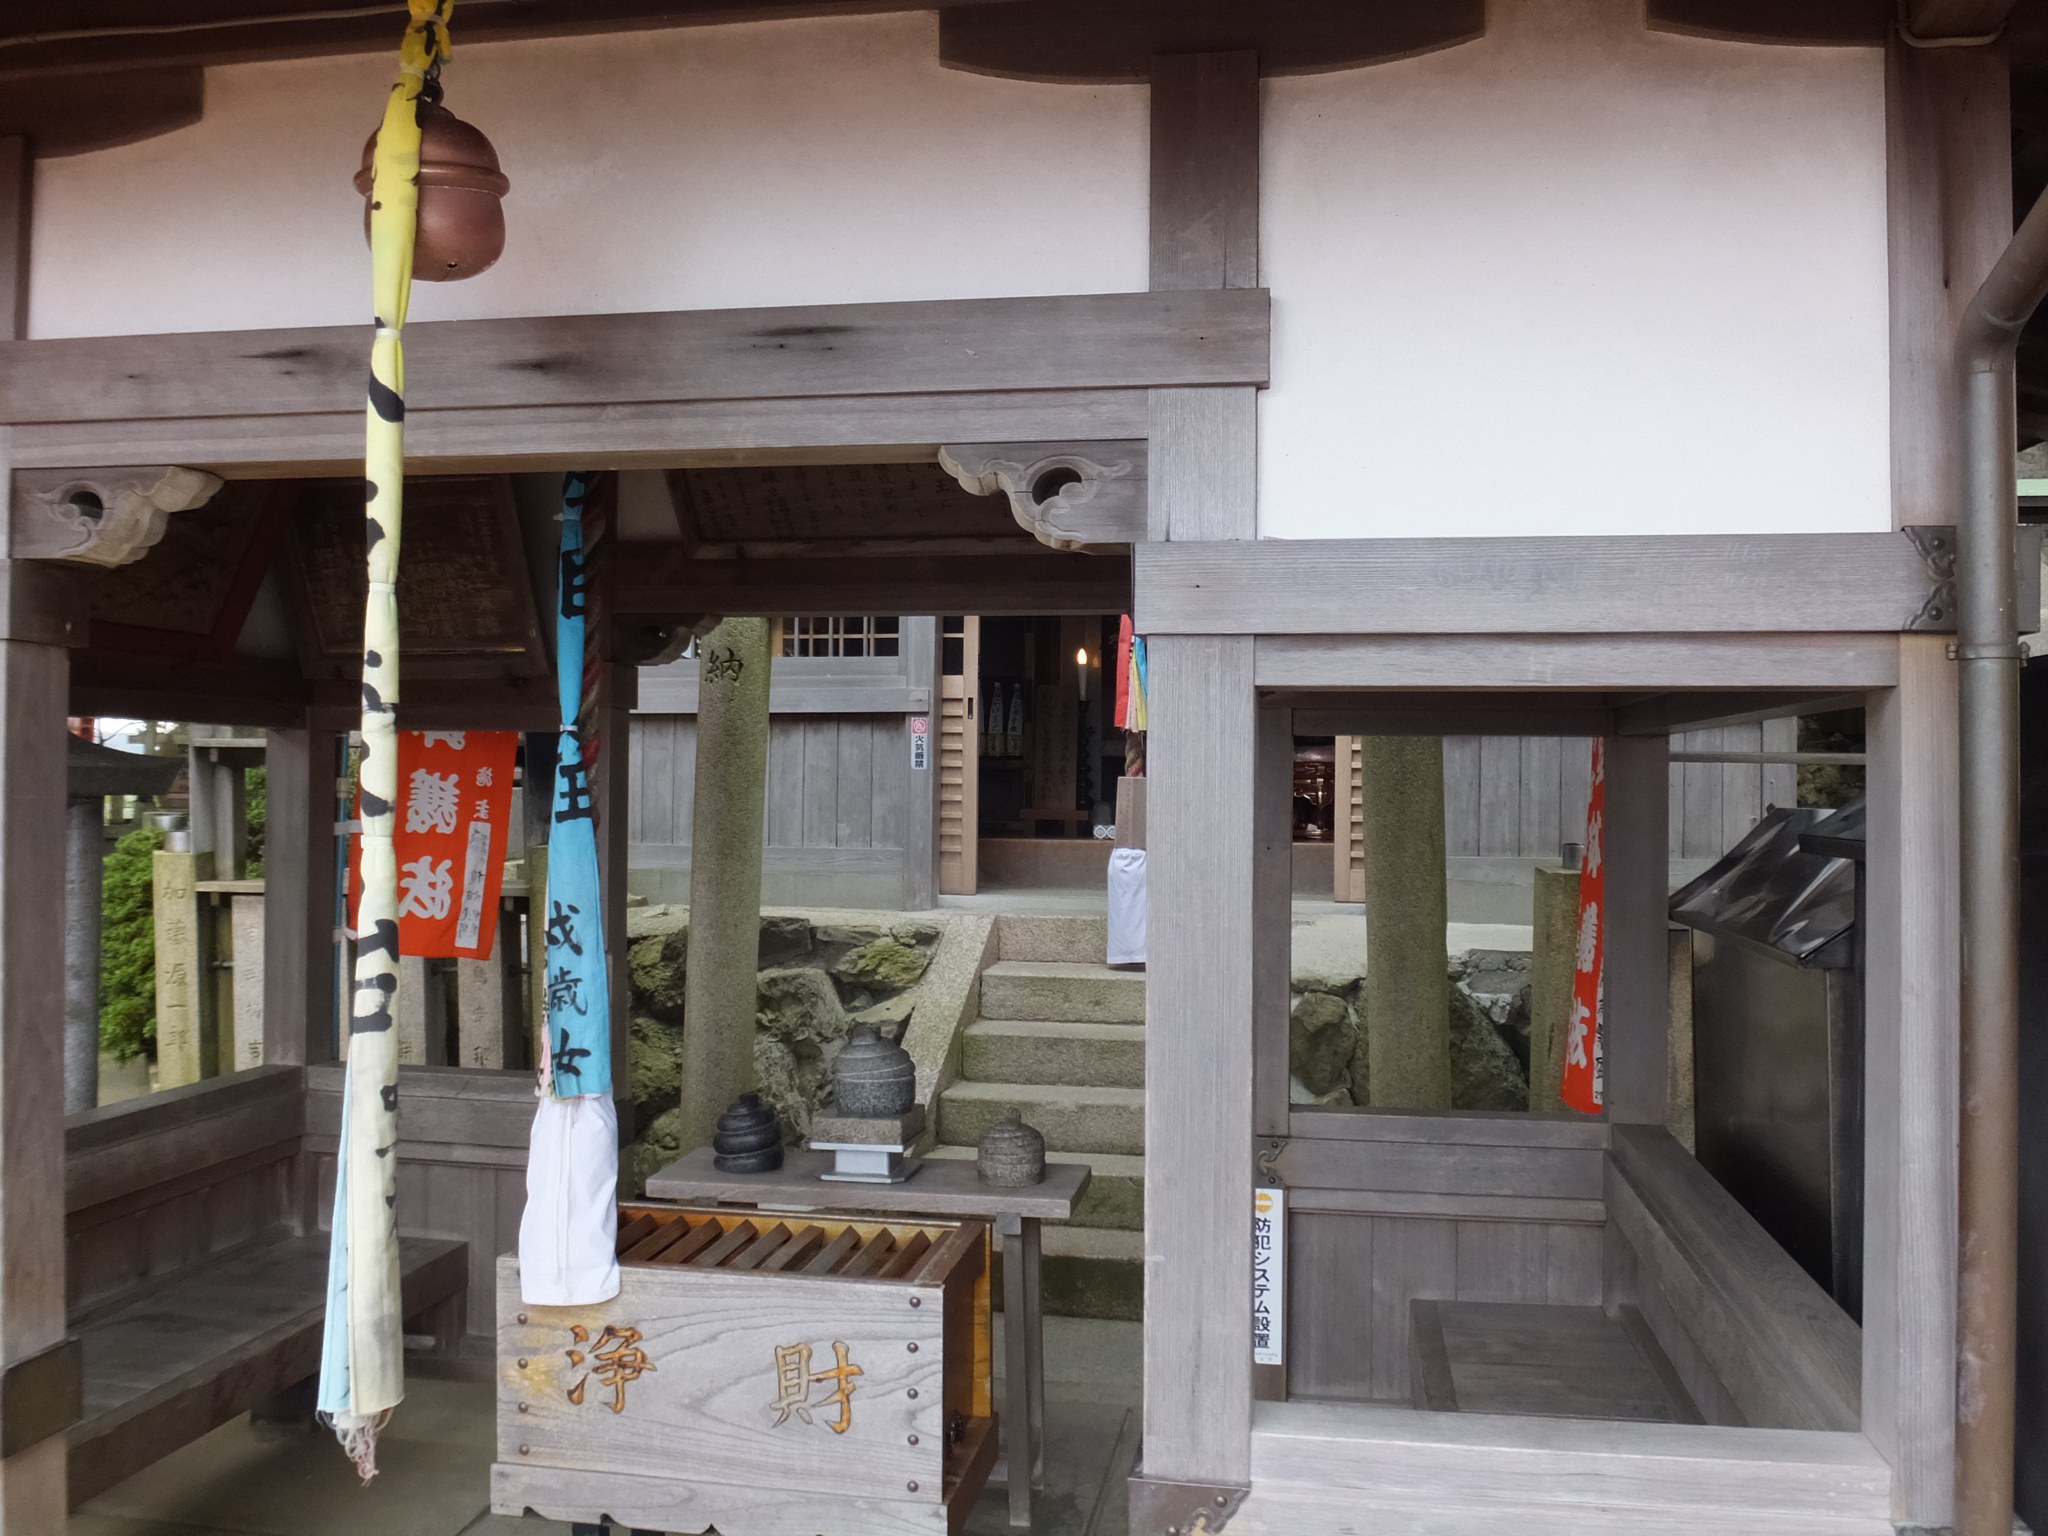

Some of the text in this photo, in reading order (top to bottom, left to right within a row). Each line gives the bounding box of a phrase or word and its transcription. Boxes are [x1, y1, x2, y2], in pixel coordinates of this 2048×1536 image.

[704, 647, 744, 684] 納
[1254, 1217, 1272, 1349] 防犯システム設置
[565, 1324, 865, 1435] 浄財
